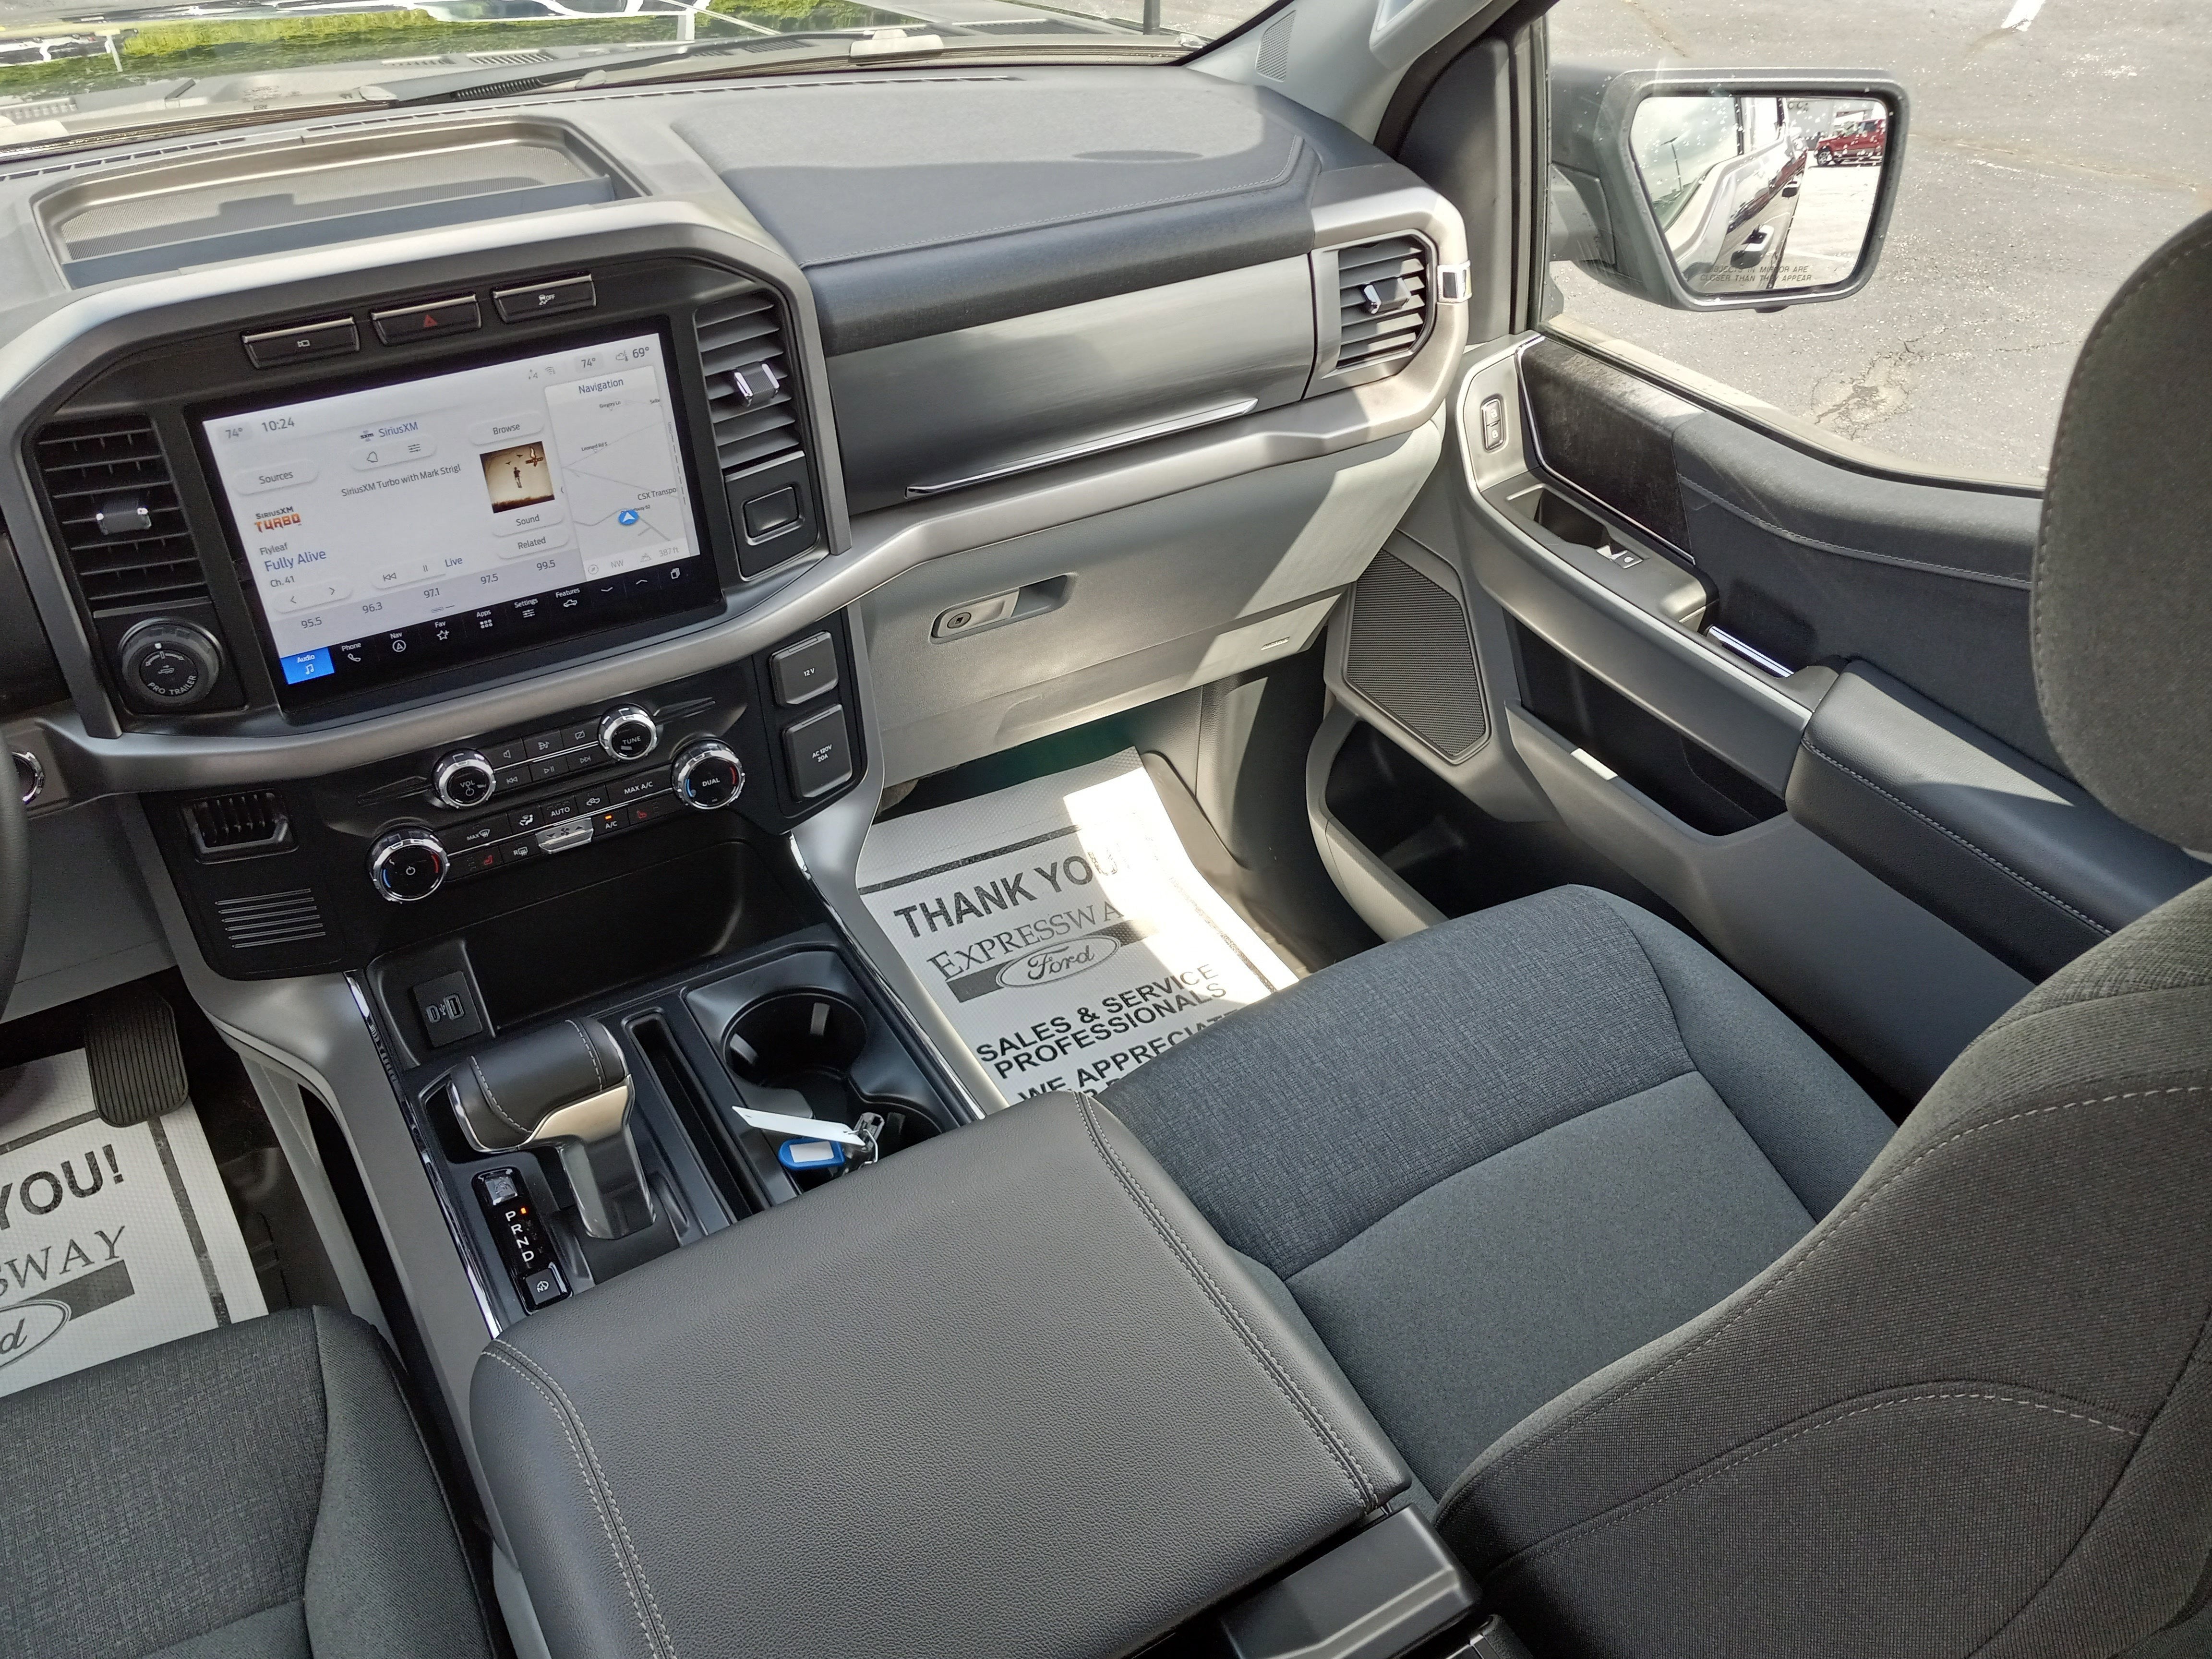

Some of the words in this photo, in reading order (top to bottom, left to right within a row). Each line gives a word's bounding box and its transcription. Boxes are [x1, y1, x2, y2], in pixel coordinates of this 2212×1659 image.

[578, 379, 624, 394] Navigation
[262, 418, 295, 432] 10:24
[379, 421, 418, 437] SiriusXM
[493, 423, 520, 435] Browse
[581, 443, 598, 451] Leonard
[259, 470, 294, 485] Sources
[342, 482, 376, 497] SiriusXM
[376, 478, 400, 489] Turbo
[401, 472, 419, 483] with
[420, 469, 439, 480] Mark
[441, 464, 461, 475] Strigl
[637, 492, 651, 500] CSX
[651, 487, 677, 497] Transpo
[254, 513, 301, 533] TURBO
[516, 514, 540, 526] Sound
[260, 542, 288, 555] Flyleaf
[517, 537, 546, 550] Related
[659, 548, 672, 557] 387
[264, 557, 294, 572] Fully
[298, 551, 327, 565] Alive
[445, 557, 463, 567] Live
[536, 560, 556, 571] 99.5
[611, 559, 624, 568] NW
[270, 579, 284, 588] Ch.
[285, 576, 295, 584] 41
[481, 573, 499, 584] 97.5
[423, 588, 440, 599] 97.1
[555, 588, 580, 598] Features
[362, 602, 383, 613] 96.3
[514, 598, 538, 608] Settings
[476, 609, 491, 618] Apps
[301, 616, 323, 629] 95.5
[341, 642, 361, 652] Phone
[297, 653, 315, 663] Audio
[147, 682, 166, 695] PRO
[168, 674, 197, 696] TRAILER
[622, 736, 641, 745] TUNE
[820, 744, 832, 753] 120V
[818, 754, 829, 762] 20A
[460, 780, 475, 788] VOL
[624, 786, 639, 794] MAX
[641, 781, 653, 789] A/C
[702, 778, 720, 787] DUAL
[551, 806, 570, 817] AUTO
[605, 821, 617, 829] A/C
[893, 872, 1038, 939] THANK
[926, 902, 1125, 982] EXPRESSWA
[1027, 944, 1095, 982] Ford
[976, 1015, 1071, 1062] SALES
[1077, 1006, 1100, 1023] &
[1102, 963, 1221, 1013] SERVICE
[994, 982, 1227, 1079] PROFESSIONALS
[505, 1211, 516, 1221] P
[511, 1224, 523, 1234] R
[517, 1236, 529, 1248] N
[522, 1251, 534, 1262] D
